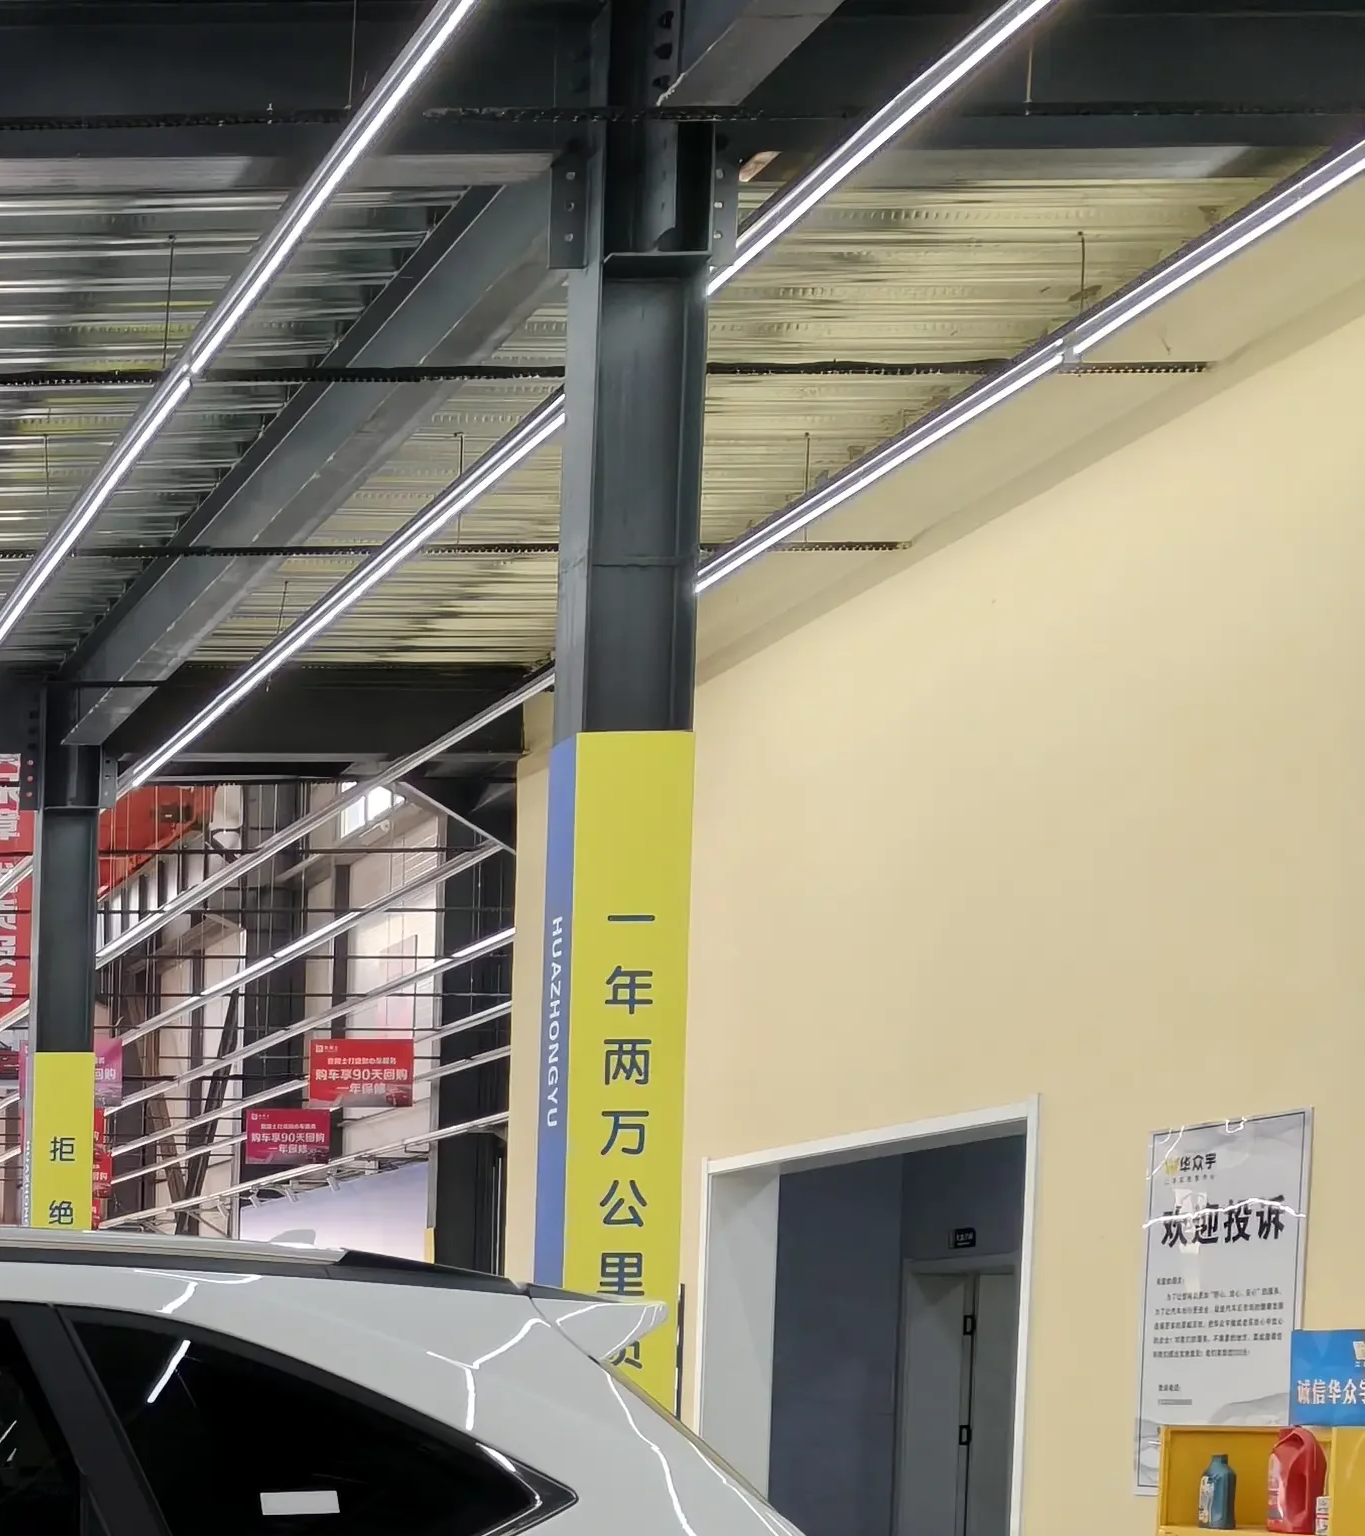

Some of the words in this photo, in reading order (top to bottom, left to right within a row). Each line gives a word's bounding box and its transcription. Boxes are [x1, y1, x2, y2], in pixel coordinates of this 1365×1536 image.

[546, 915, 564, 1128] HUAZHONGYU
[315, 1068, 408, 1081] 购车享90天回购
[336, 1082, 387, 1095] 一年保修
[251, 1132, 325, 1143] 购车享90天回购
[1179, 1153, 1217, 1172] 华众宇
[49, 1136, 75, 1226] 拒绝
[1161, 1194, 1285, 1248] 欢迎投诉
